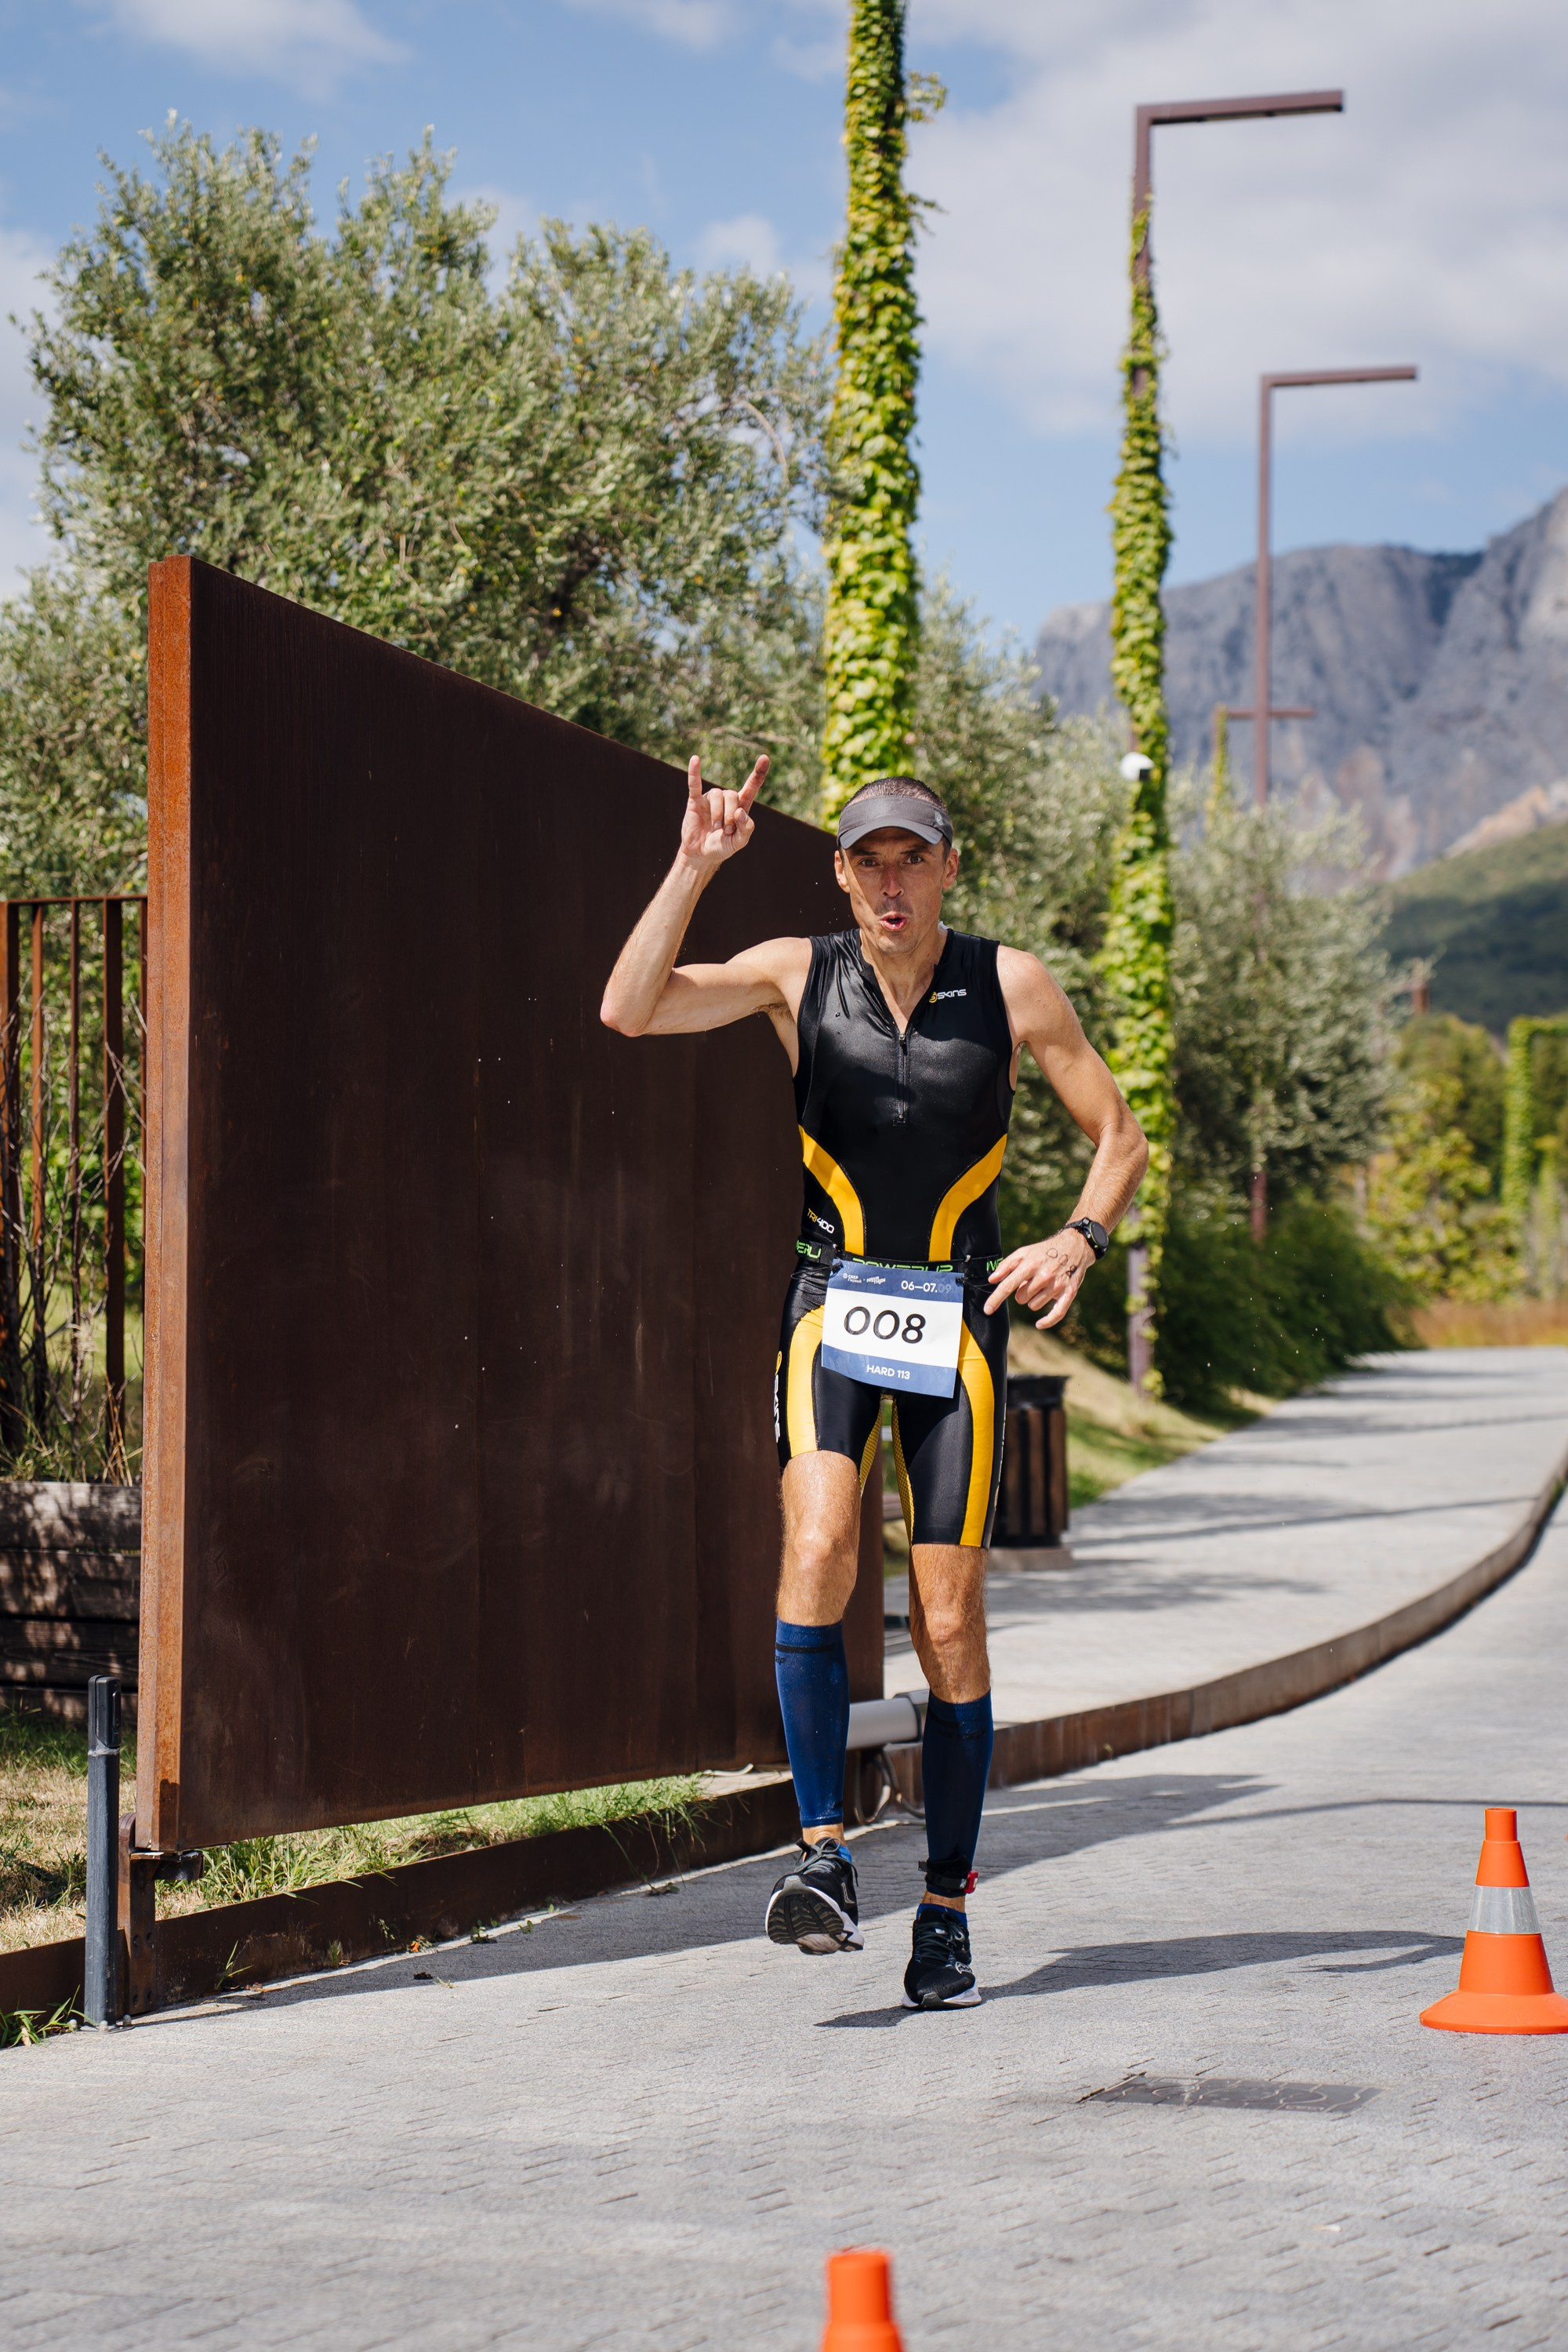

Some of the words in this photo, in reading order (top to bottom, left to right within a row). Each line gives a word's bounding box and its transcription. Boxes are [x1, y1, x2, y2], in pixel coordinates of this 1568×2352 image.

[844, 1306, 926, 1344] 008
[866, 1364, 895, 1377] HARD
[897, 1369, 911, 1380] 113
